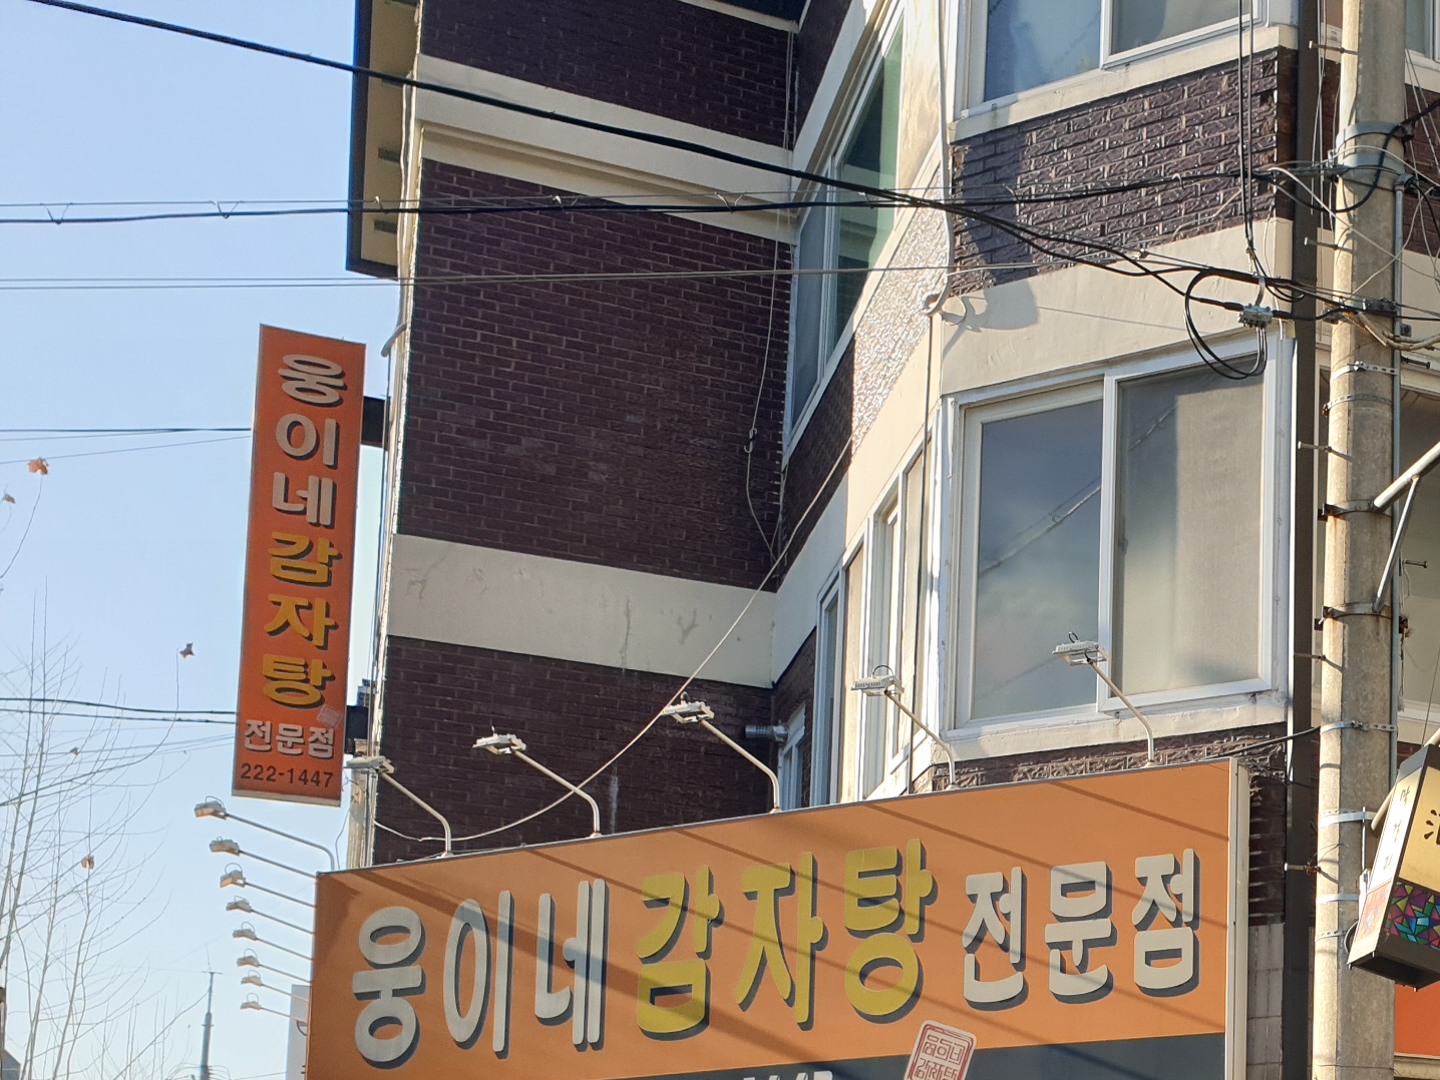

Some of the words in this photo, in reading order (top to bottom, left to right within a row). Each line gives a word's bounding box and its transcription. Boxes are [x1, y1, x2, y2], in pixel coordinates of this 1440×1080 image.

[272, 353, 345, 527] 웅이네
[261, 530, 342, 709] 감자탕
[240, 763, 334, 788] 222-1447
[243, 719, 336, 760] 전문점
[352, 878, 606, 1067] 웅이네
[635, 837, 938, 1041] 감자탕
[962, 848, 1201, 1011] 전문점
